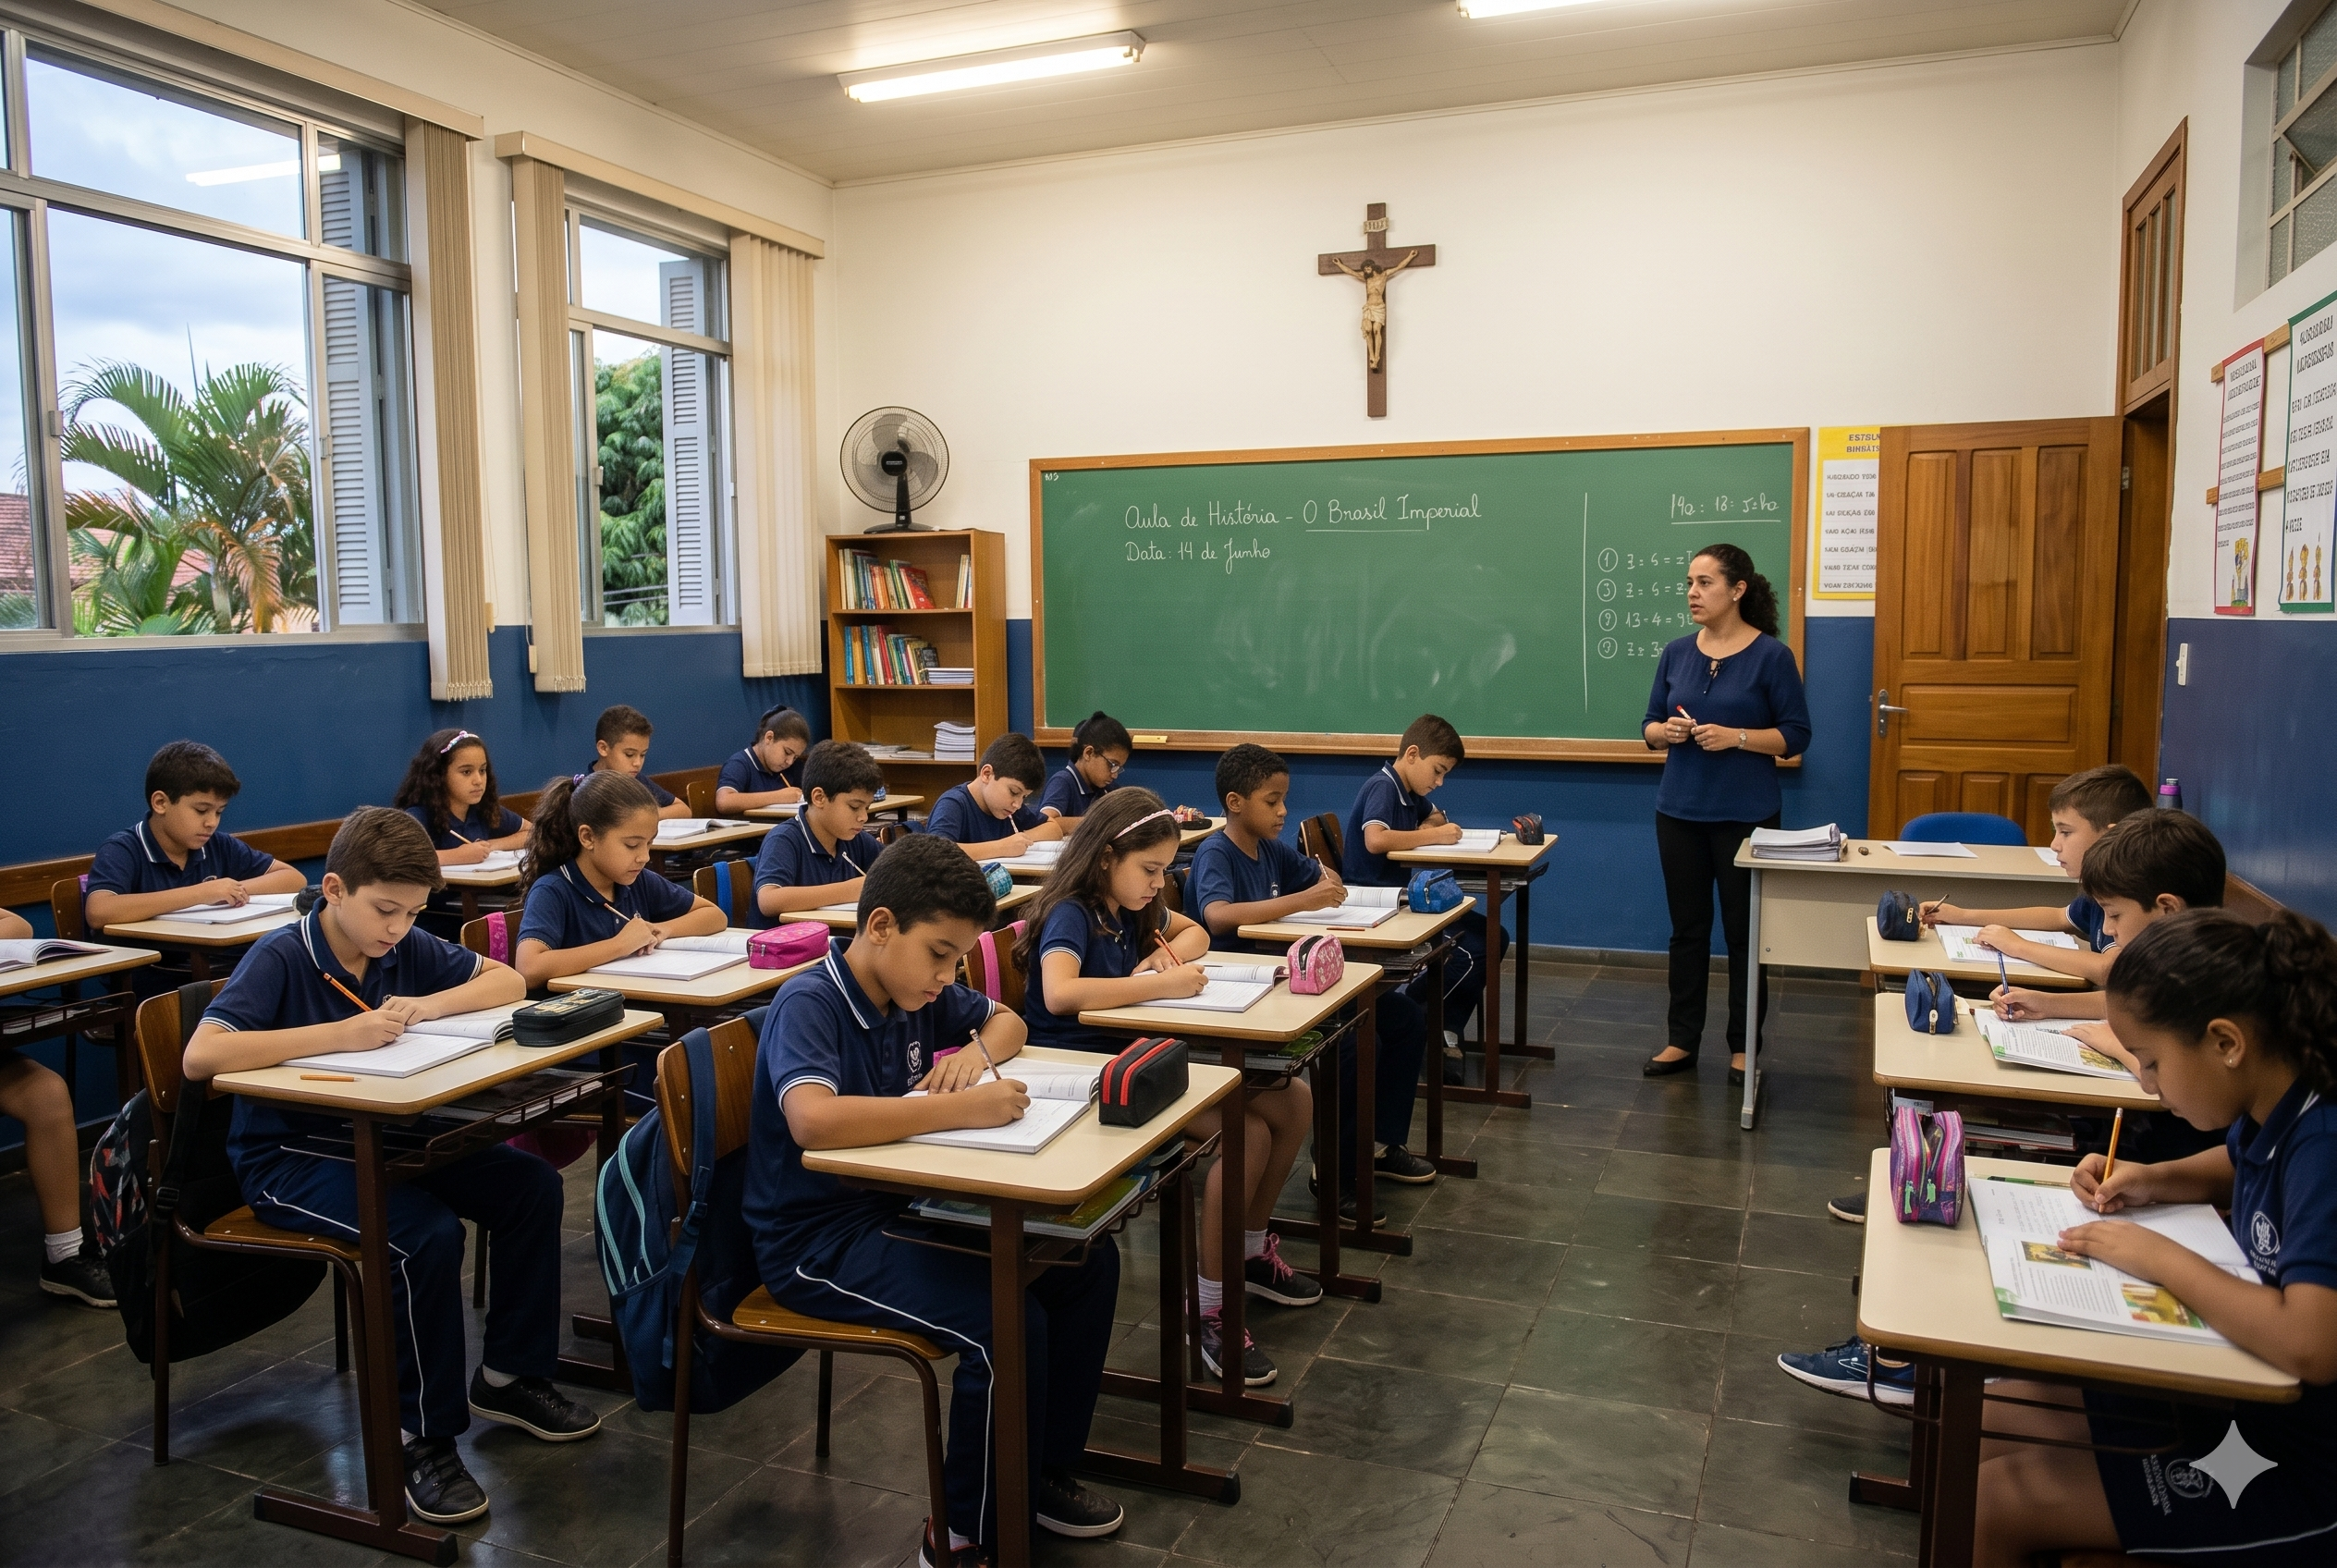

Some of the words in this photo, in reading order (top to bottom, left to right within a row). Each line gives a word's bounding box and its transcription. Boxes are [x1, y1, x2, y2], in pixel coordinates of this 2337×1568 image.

[1125, 503, 1171, 529] Aula
[1181, 507, 1199, 527] de
[1207, 499, 1280, 526] História
[1303, 500, 1317, 524] O
[1328, 496, 1388, 523] Brasil
[1397, 494, 1483, 531] Imperial
[1125, 540, 1172, 561] Data:
[1177, 541, 1193, 559] 14
[1201, 542, 1218, 560] de
[1223, 537, 1270, 575] Junho
